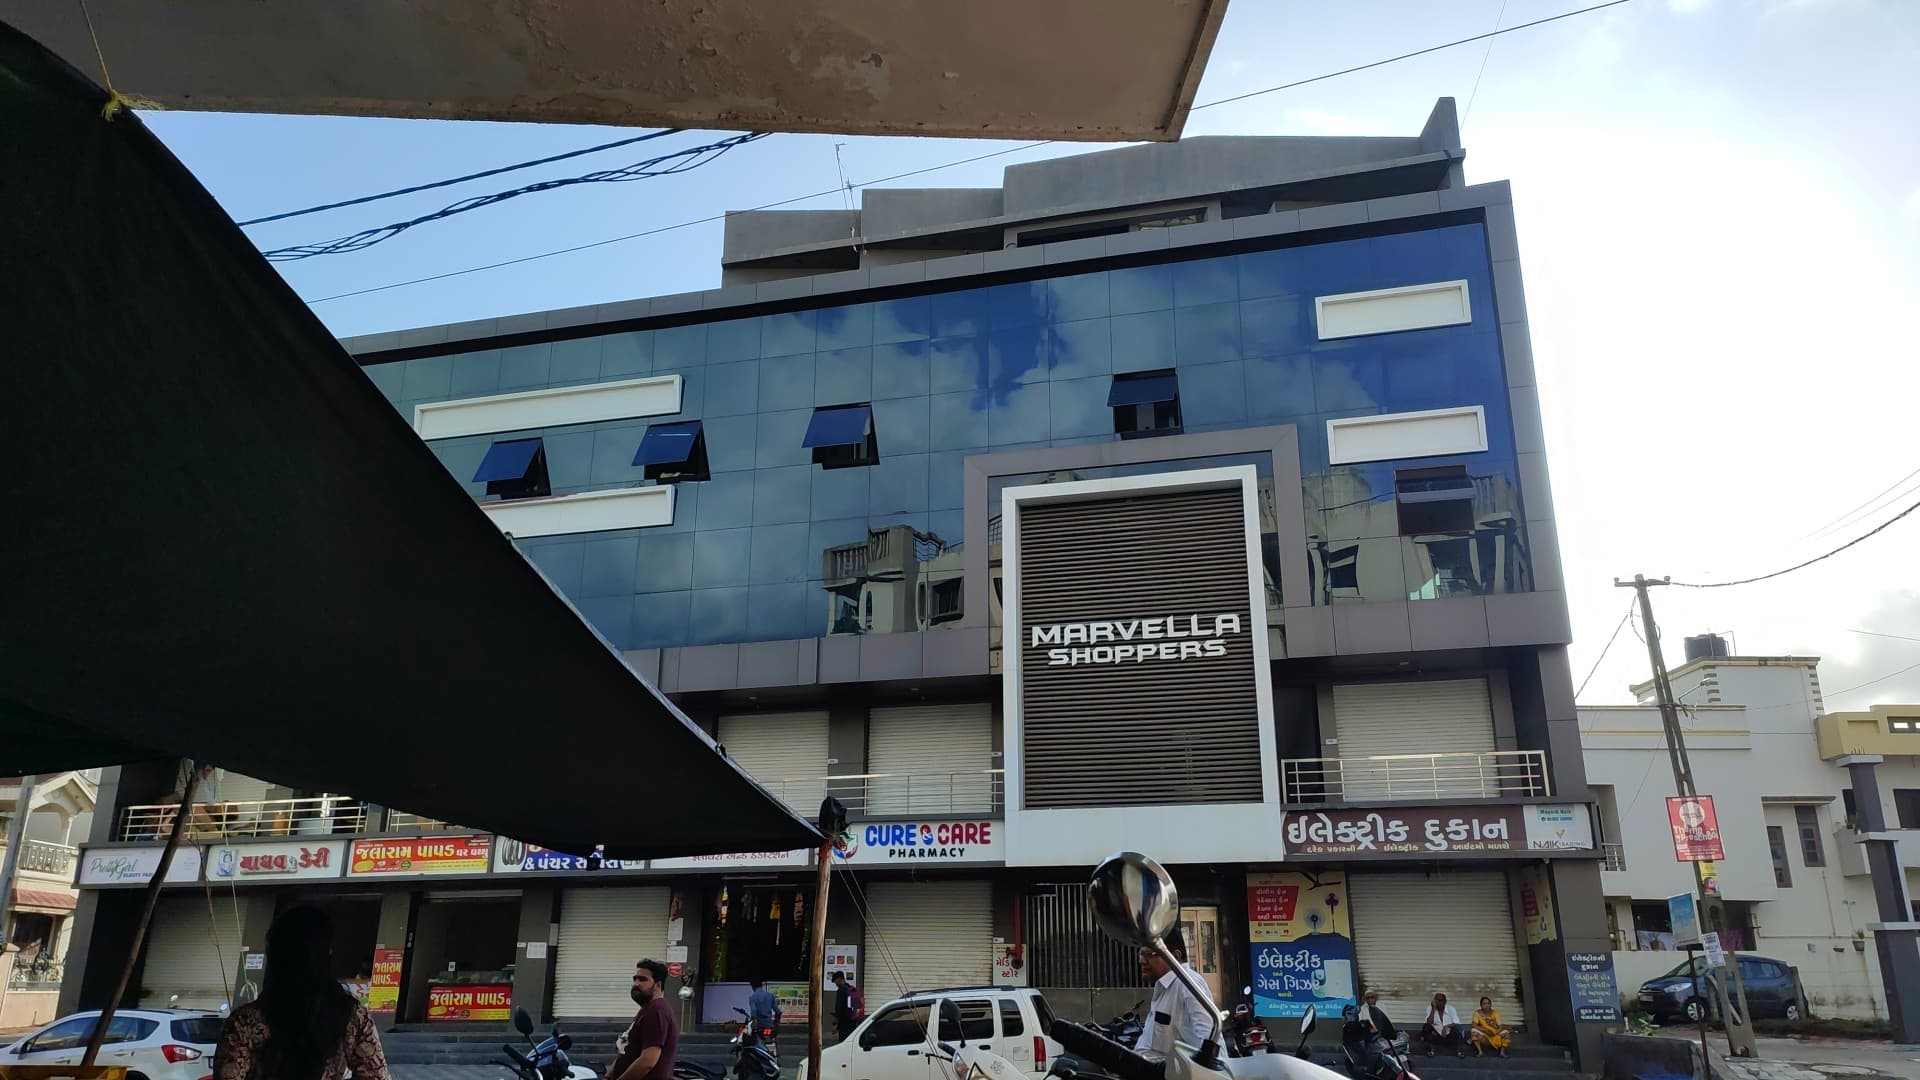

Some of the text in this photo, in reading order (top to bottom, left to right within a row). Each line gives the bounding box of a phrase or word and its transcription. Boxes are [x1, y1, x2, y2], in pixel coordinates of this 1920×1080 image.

[1031, 614, 1240, 648] MARVELLA
[1048, 639, 1227, 667] SHOPPERS
[865, 824, 917, 847] CURE
[937, 822, 991, 845] CARE
[1424, 818, 1508, 851] દુકાન
[298, 847, 330, 869] ડેરી
[356, 845, 412, 860] જલારામ
[417, 844, 455, 858] પાપડ
[889, 847, 965, 858] PHARMACY
[524, 857, 535, 870] &
[538, 853, 570, 869] પંચર
[1001, 967, 1018, 978] સ્ટોર
[1258, 974, 1280, 990] ગેસ
[430, 993, 473, 1006] જલારામ
[477, 993, 505, 1006] પાપડ
